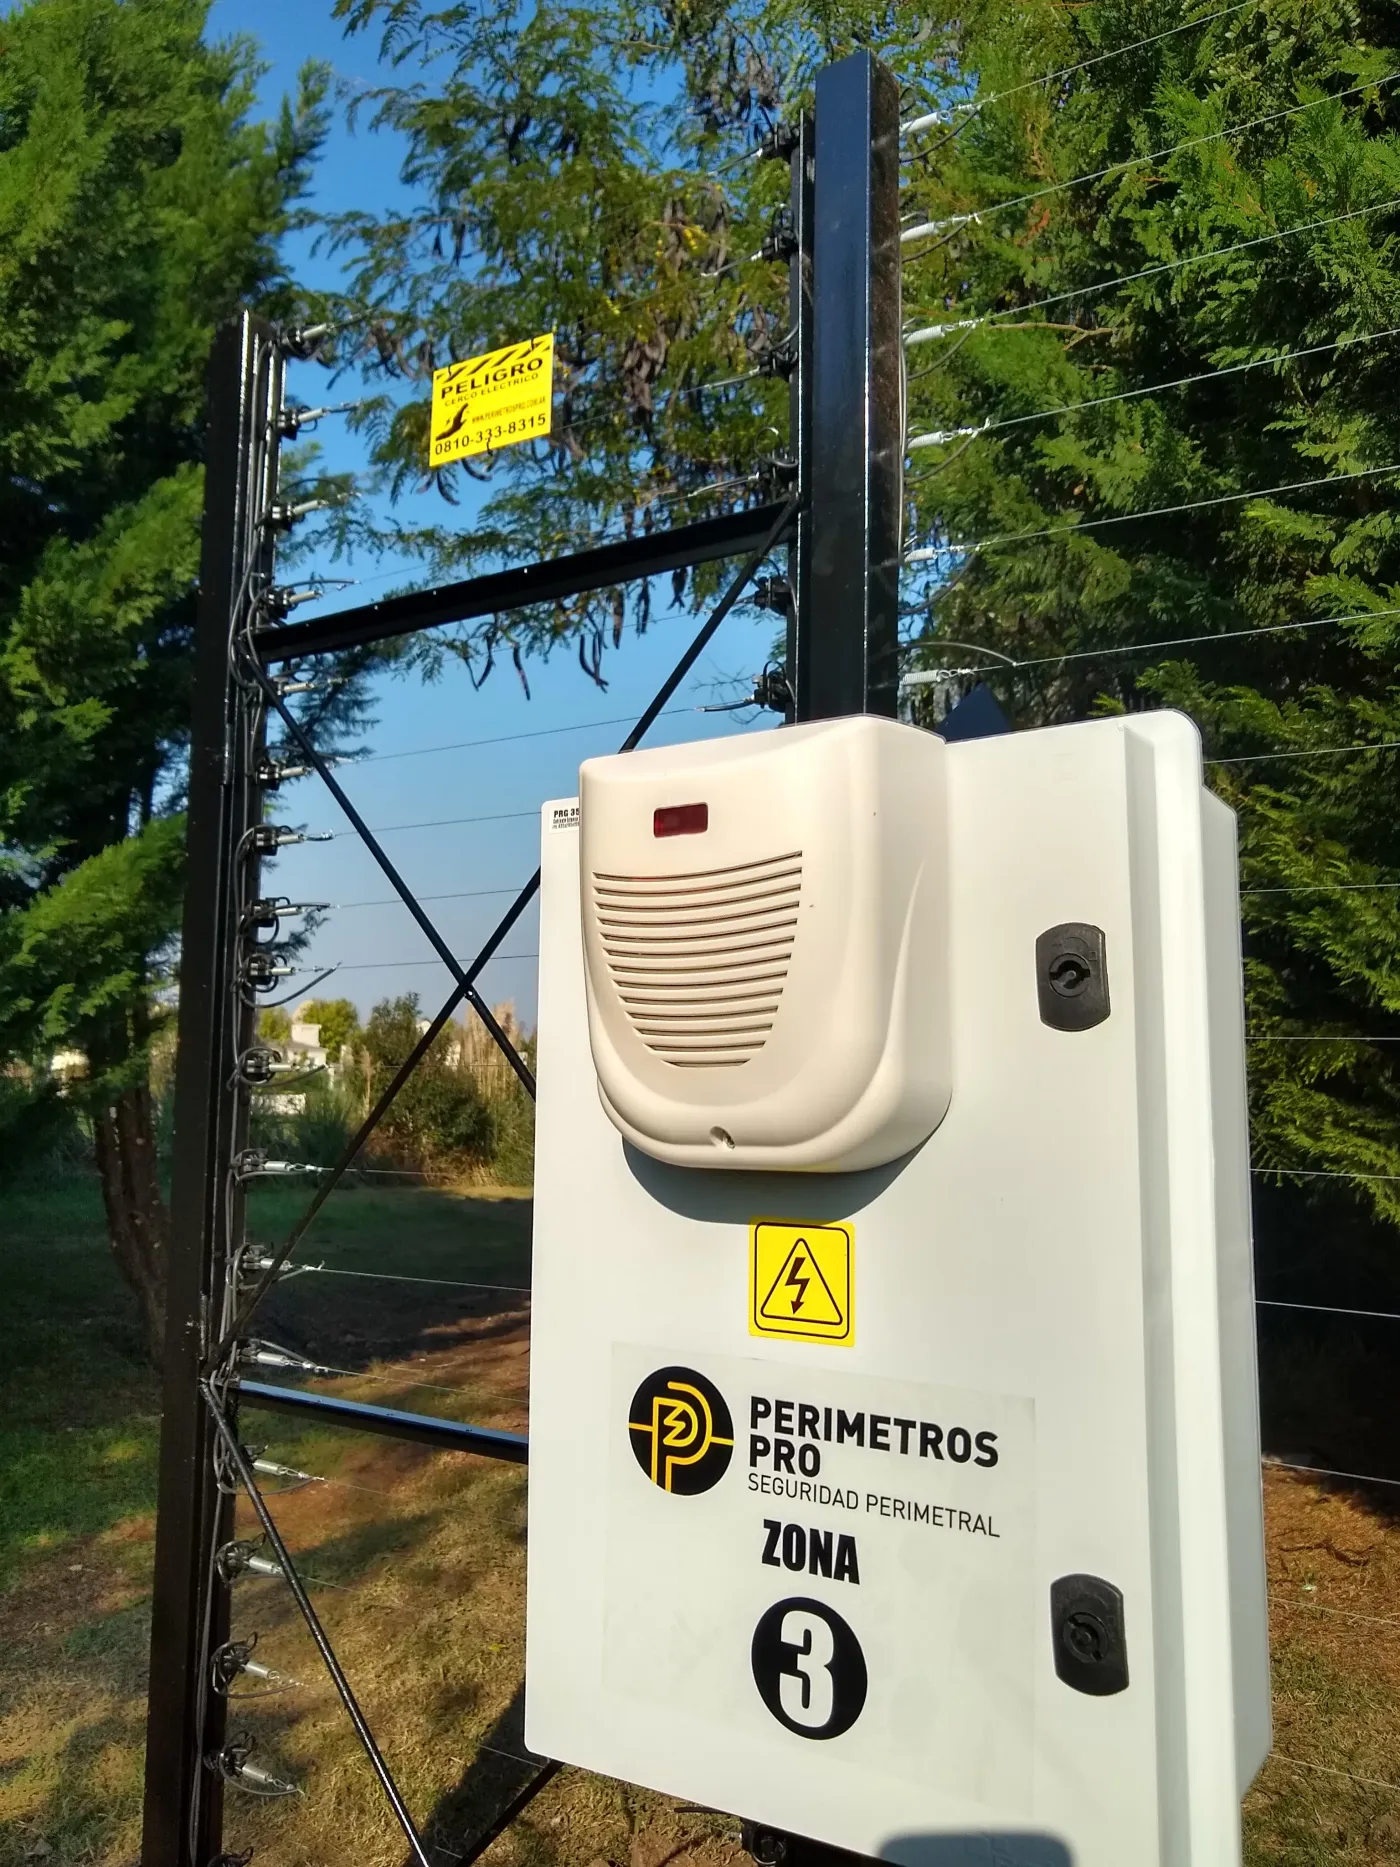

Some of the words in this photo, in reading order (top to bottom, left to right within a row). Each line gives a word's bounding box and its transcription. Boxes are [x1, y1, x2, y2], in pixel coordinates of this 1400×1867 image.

[441, 358, 543, 400] PELIGRO
[444, 392, 478, 406] CERCO
[481, 373, 538, 395] ELECTRICO
[435, 413, 546, 455] 0810-333-8315
[554, 810, 568, 818] PRG
[750, 1396, 999, 1468] PERIMETROS
[749, 1434, 821, 1478] PRO
[748, 1473, 859, 1510] SEGURIDAD
[866, 1494, 1000, 1538] PERIMETRAL
[761, 1518, 861, 1586] ZONA
[779, 1610, 834, 1729] 3
